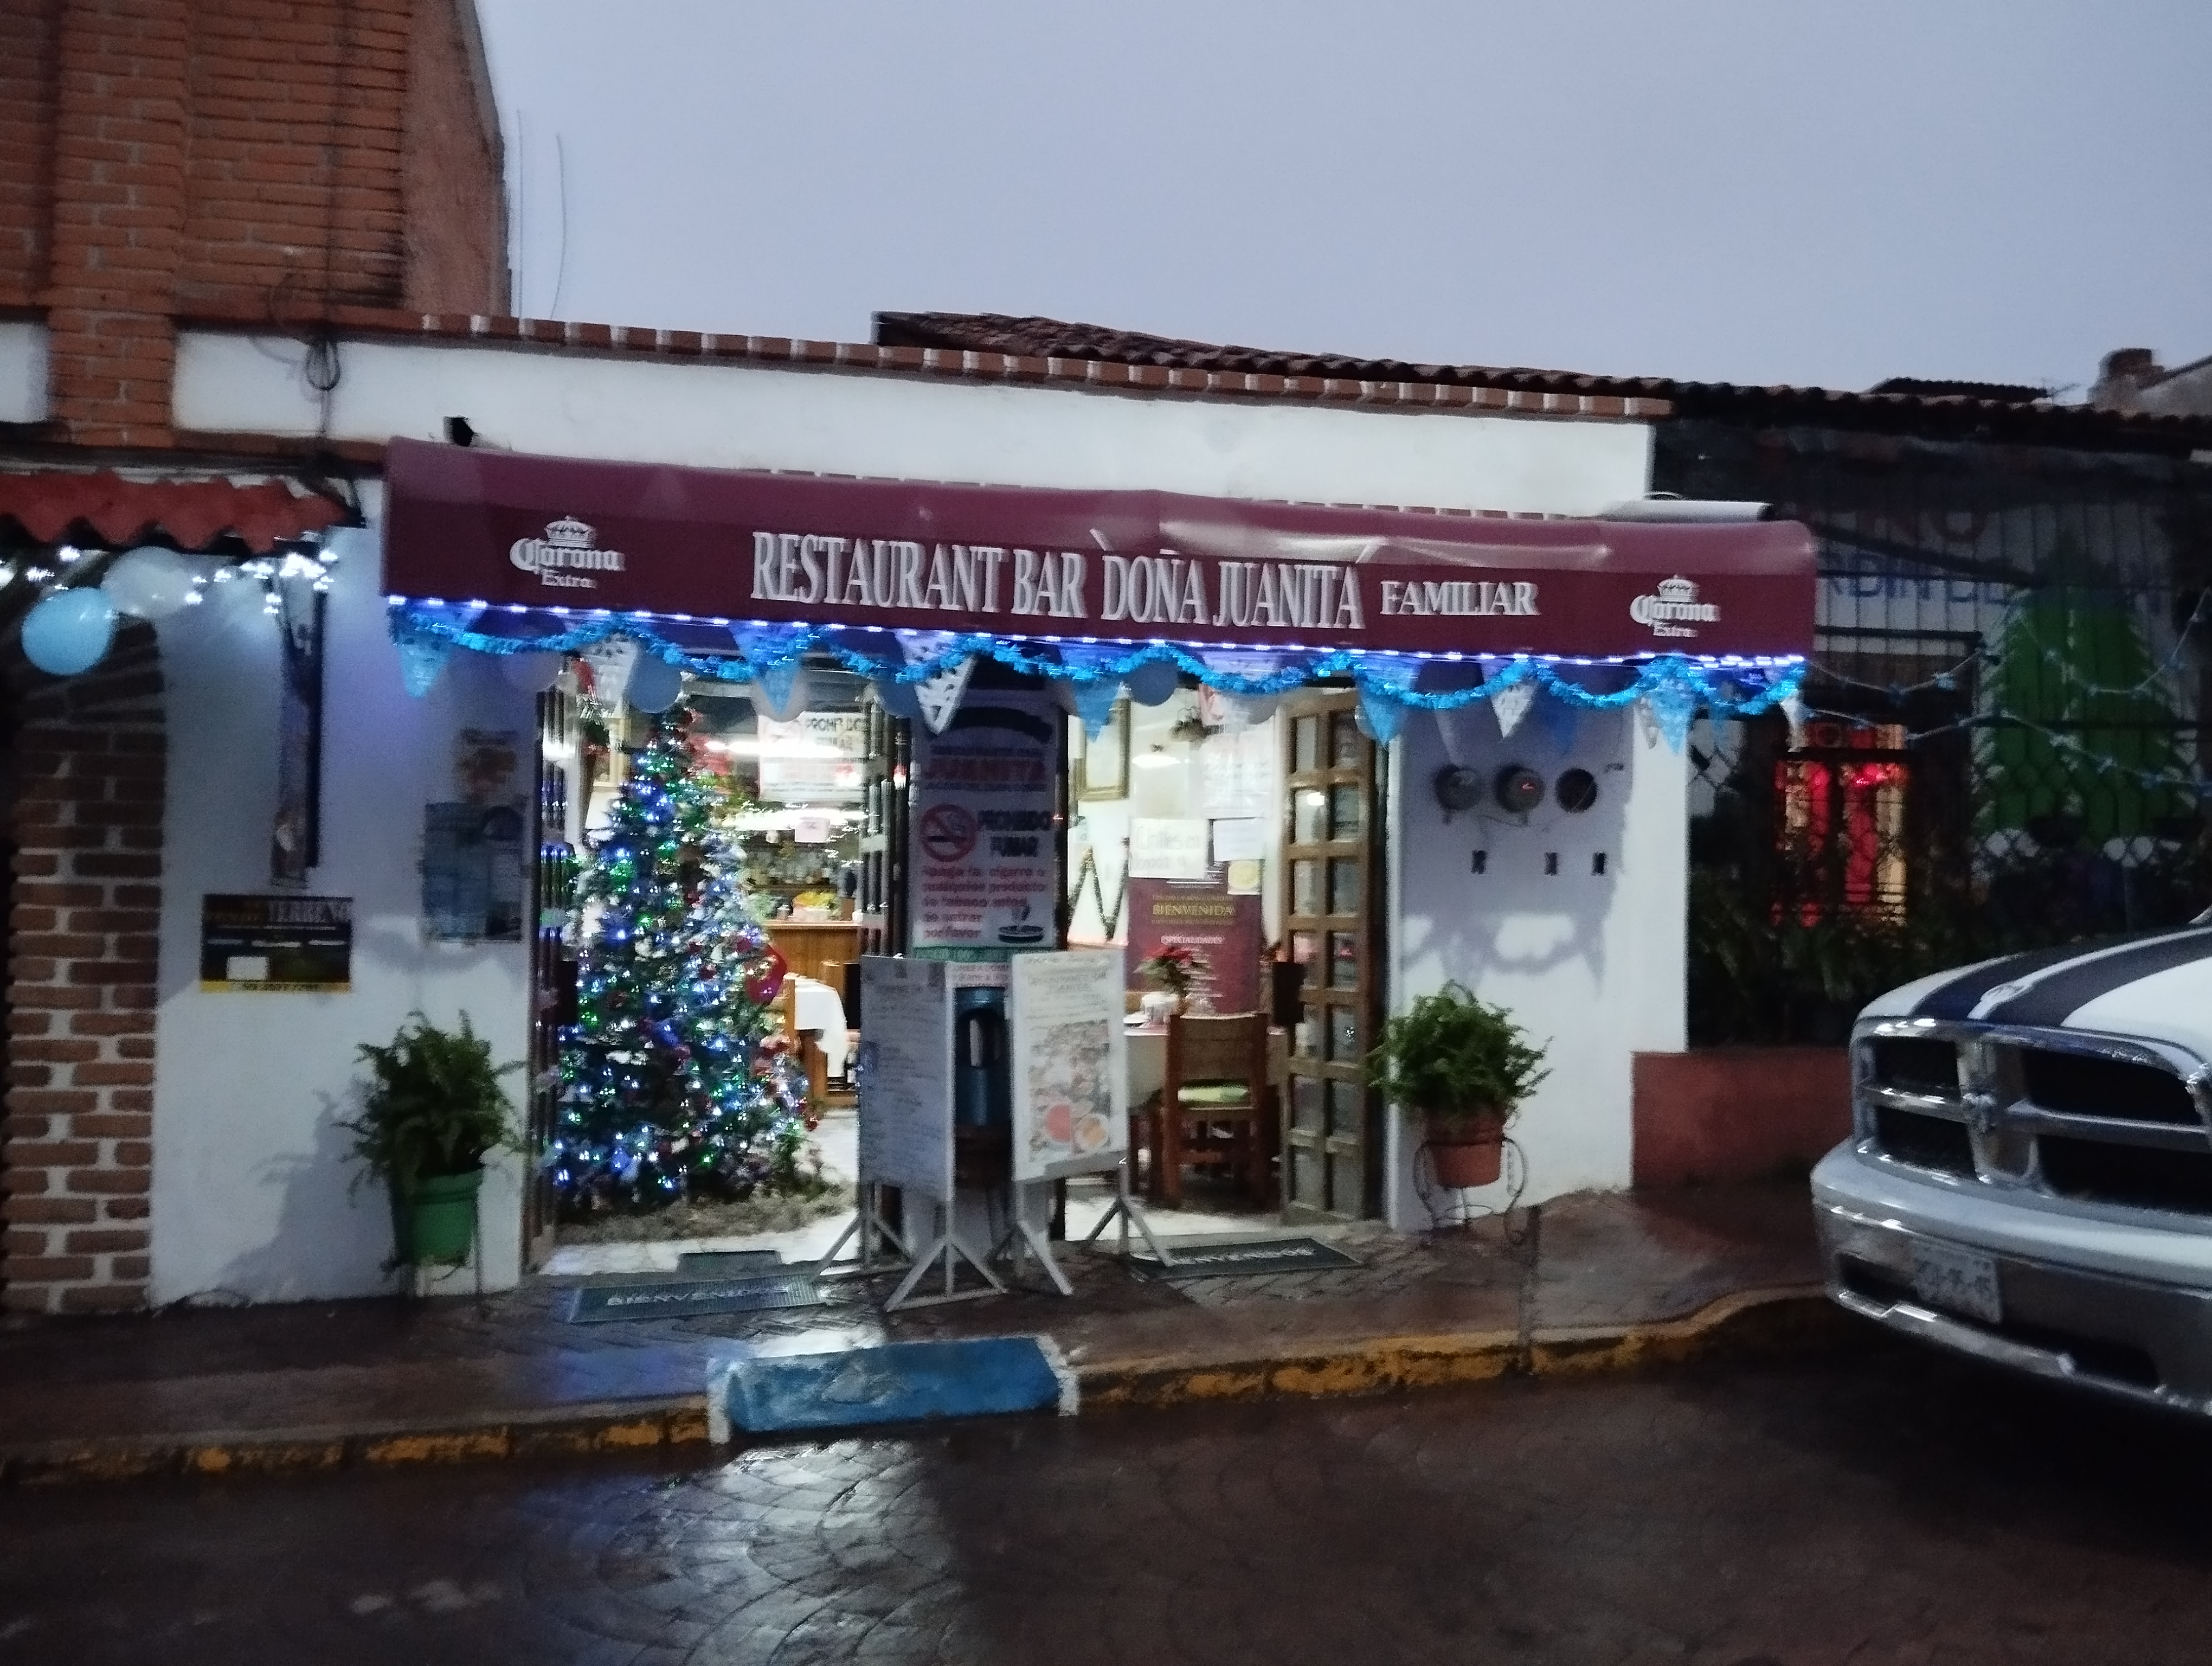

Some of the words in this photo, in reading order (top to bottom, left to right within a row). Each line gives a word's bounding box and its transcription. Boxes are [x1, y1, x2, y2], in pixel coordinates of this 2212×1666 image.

[510, 537, 626, 574] Corona
[541, 568, 598, 588] Extra
[750, 531, 1007, 612] RESTAURANT
[1011, 549, 1088, 618] BAR
[1101, 549, 1208, 624] DOÑA
[1213, 561, 1366, 629] JUANITA
[1380, 580, 1541, 616] FAMILIAR
[1630, 594, 1721, 626] Corona
[1653, 622, 1699, 637] Extra
